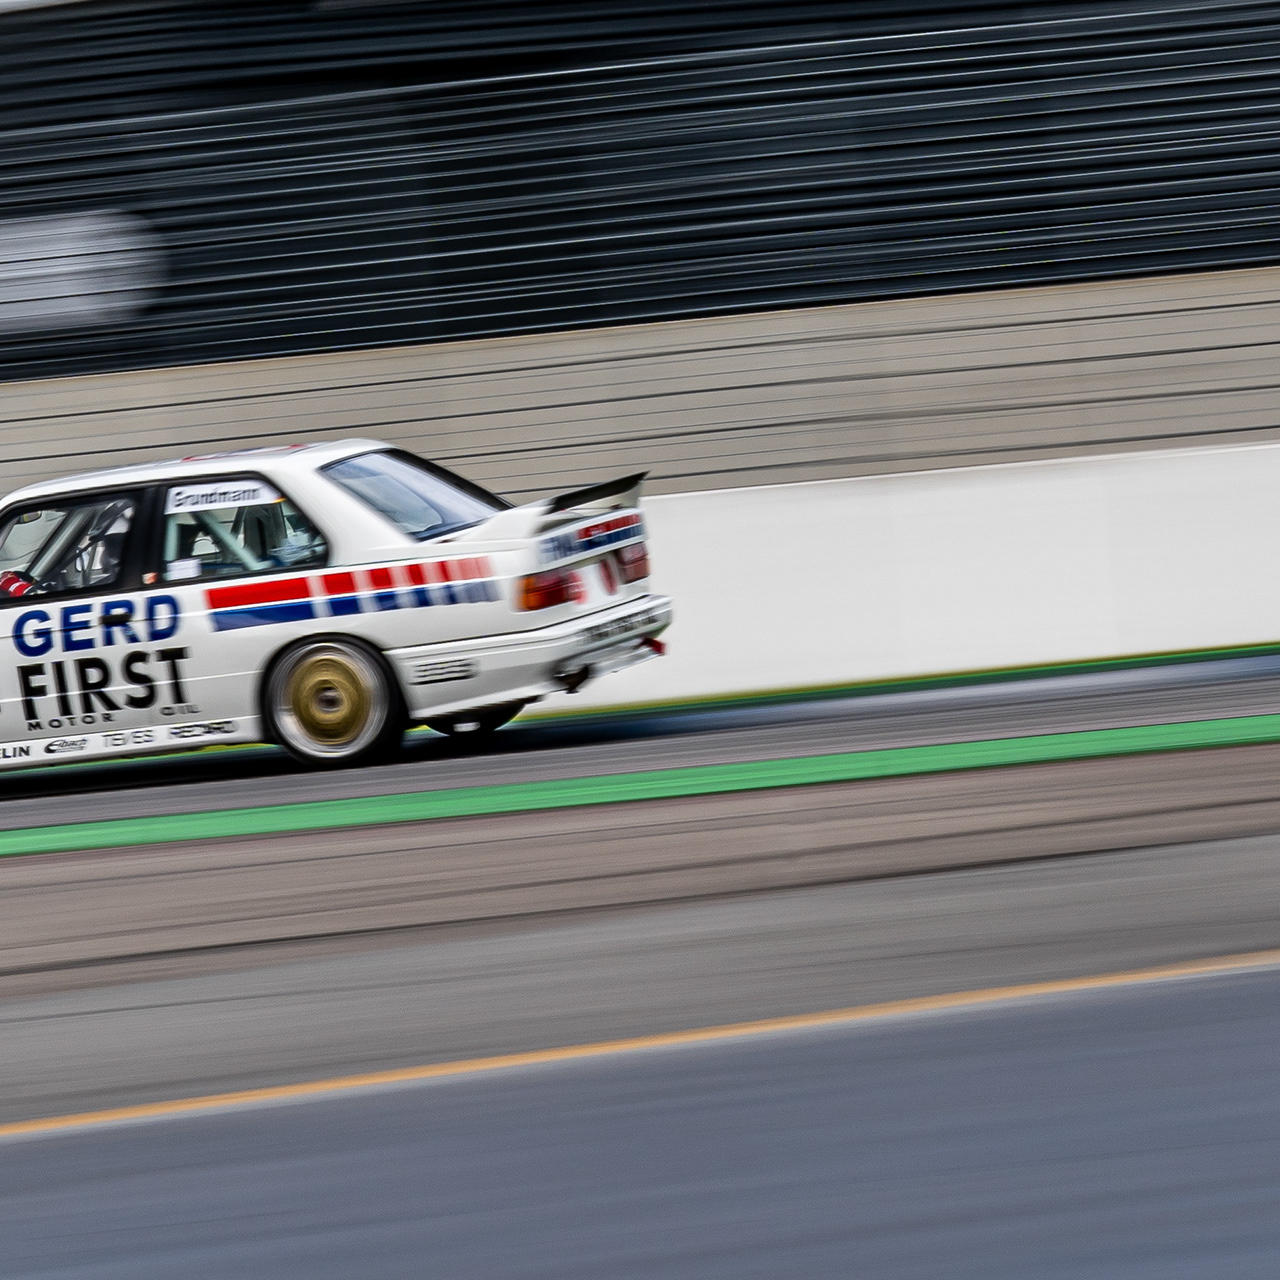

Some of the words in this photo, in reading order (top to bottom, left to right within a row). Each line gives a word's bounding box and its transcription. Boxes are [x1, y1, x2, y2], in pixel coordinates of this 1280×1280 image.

[12, 595, 182, 657] GERD
[16, 646, 192, 721] FIRST
[27, 713, 115, 732] MOTOR
